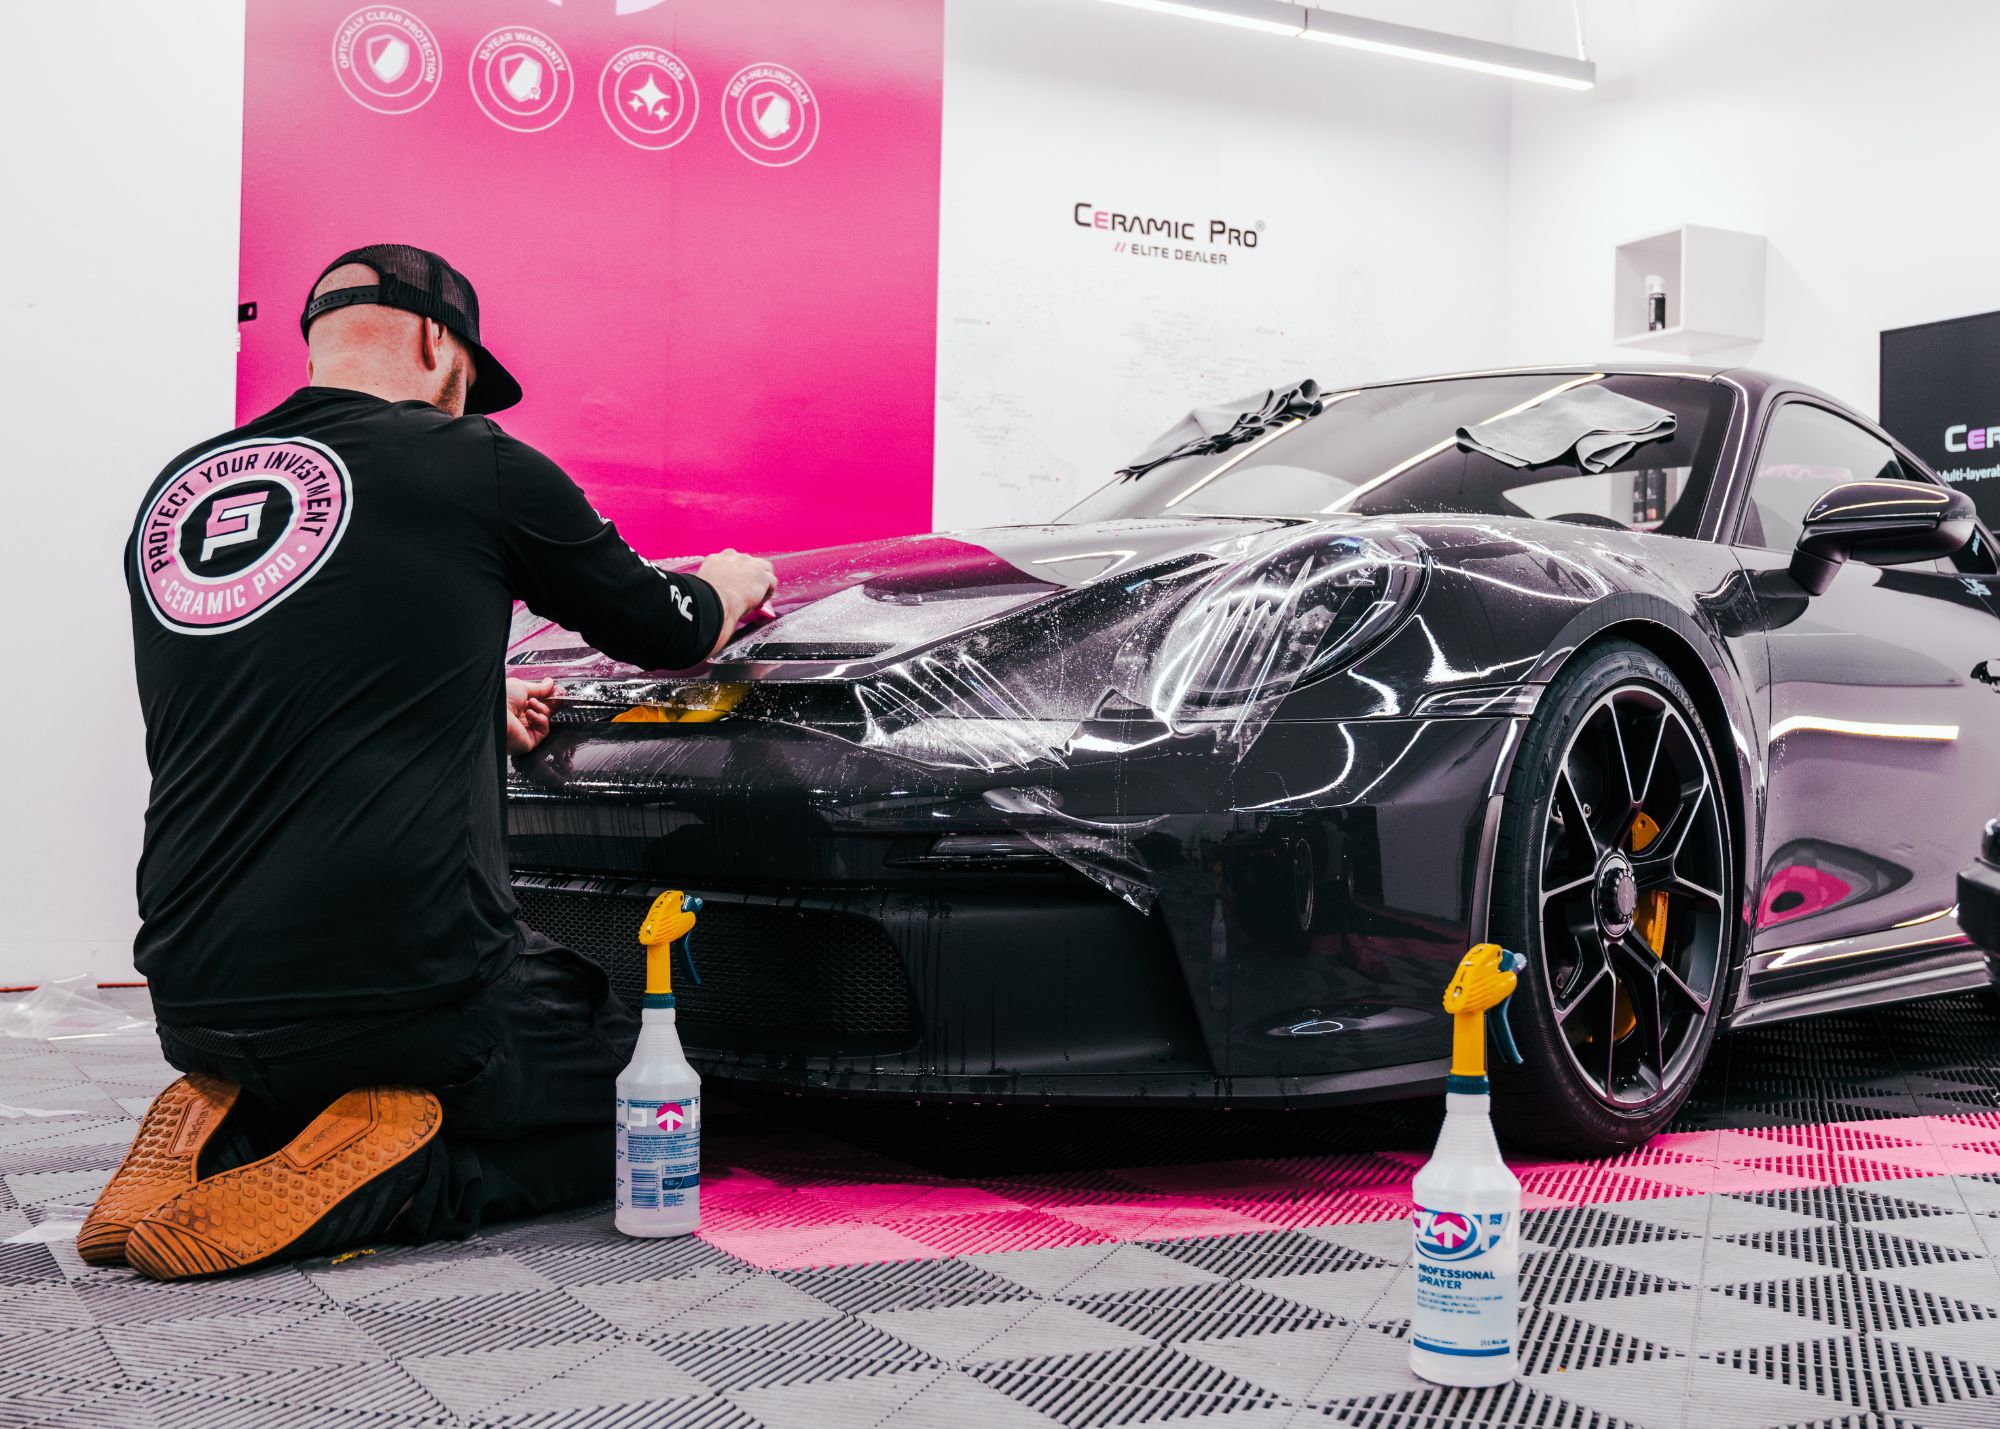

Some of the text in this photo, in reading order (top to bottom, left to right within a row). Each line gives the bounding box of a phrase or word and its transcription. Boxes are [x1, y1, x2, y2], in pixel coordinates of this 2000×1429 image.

[339, 11, 436, 83] OPTICALLY CLEAR PROTECTION
[479, 31, 566, 71] 12-YEAR WARRANTY
[612, 50, 686, 80] EXTREME GLOSS
[729, 68, 810, 104] SELF-HEALING FILM
[1074, 202, 1257, 248] CERAMIC PRO
[1131, 243, 1228, 265] ELITE DEALER
[148, 481, 195, 575] PROTECT
[199, 453, 259, 484] YOUR
[263, 450, 331, 537] INVESTMENT
[164, 552, 297, 616] CERAMIC PRO
[1418, 1263, 1495, 1280] PROFESSIONAL
[1418, 1273, 1462, 1290] SPRAYER
